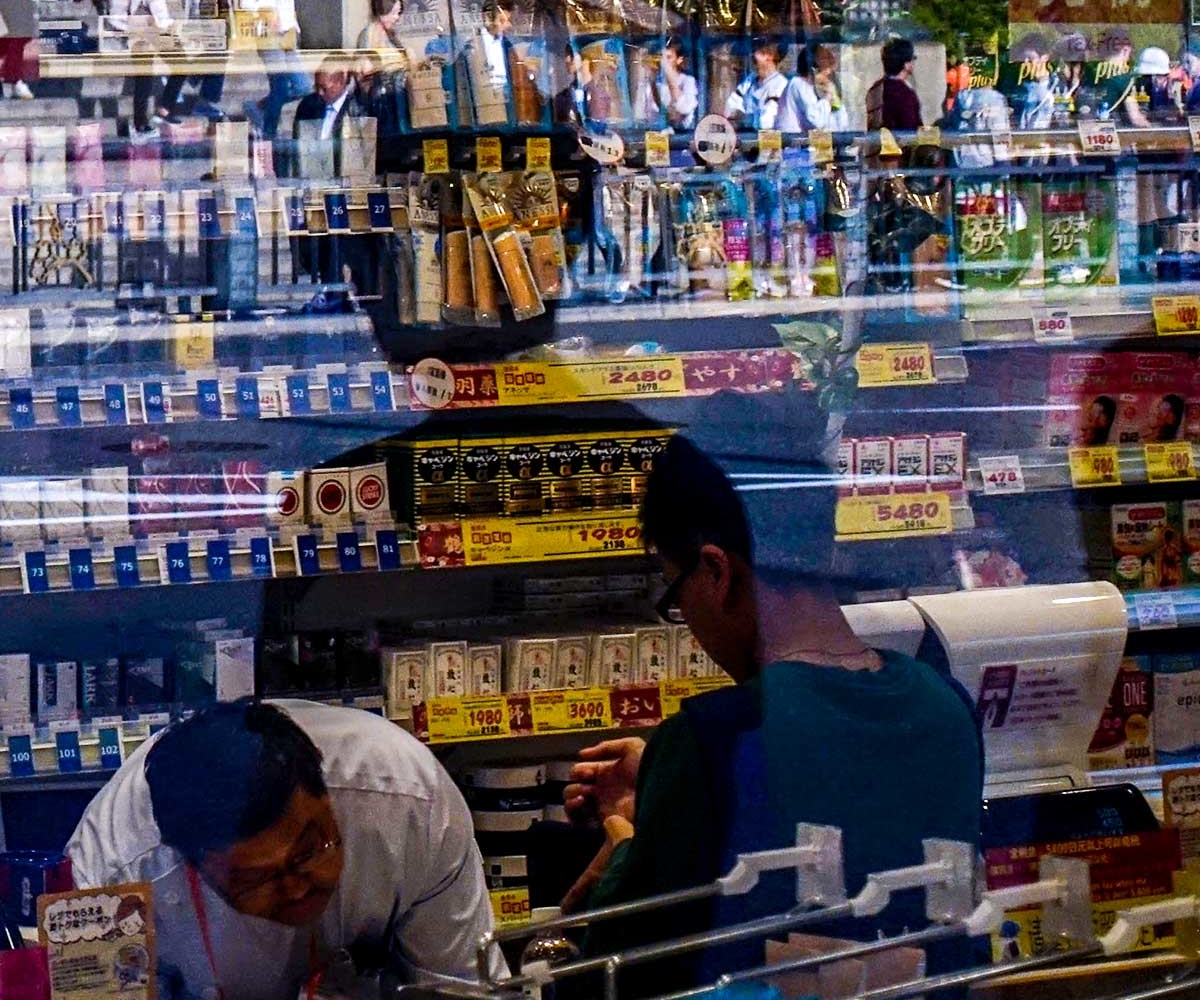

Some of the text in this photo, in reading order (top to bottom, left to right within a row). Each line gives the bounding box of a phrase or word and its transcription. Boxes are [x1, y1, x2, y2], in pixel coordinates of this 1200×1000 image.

[1086, 134, 1113, 145] 1180
[331, 206, 344, 216] 26
[374, 204, 385, 214] 27
[200, 212, 212, 223] 23
[240, 211, 251, 221] 24
[1038, 318, 1065, 332] 880
[608, 368, 672, 385] 2480
[242, 390, 254, 401] 51
[292, 388, 304, 399] 52
[332, 386, 345, 397] 53
[373, 385, 386, 396] 54
[149, 395, 161, 406] 49
[204, 392, 217, 403] 50
[15, 404, 29, 414] 46
[60, 401, 74, 412] 47
[108, 399, 121, 409] 48
[897, 465, 921, 476] EX
[933, 463, 958, 476] EX
[877, 502, 939, 522] 5480
[303, 549, 315, 560] 79
[344, 547, 356, 557] 80
[382, 544, 394, 554] 81
[171, 559, 184, 569] 76
[211, 556, 224, 567] 77
[254, 553, 267, 564] 78
[31, 567, 44, 577] 73
[77, 565, 90, 575] 74
[120, 562, 133, 572] 75
[1122, 682, 1148, 707] ONE
[469, 708, 502, 727] 1980
[58, 748, 77, 759] 101
[100, 744, 118, 755] 102
[11, 751, 30, 762] 100
